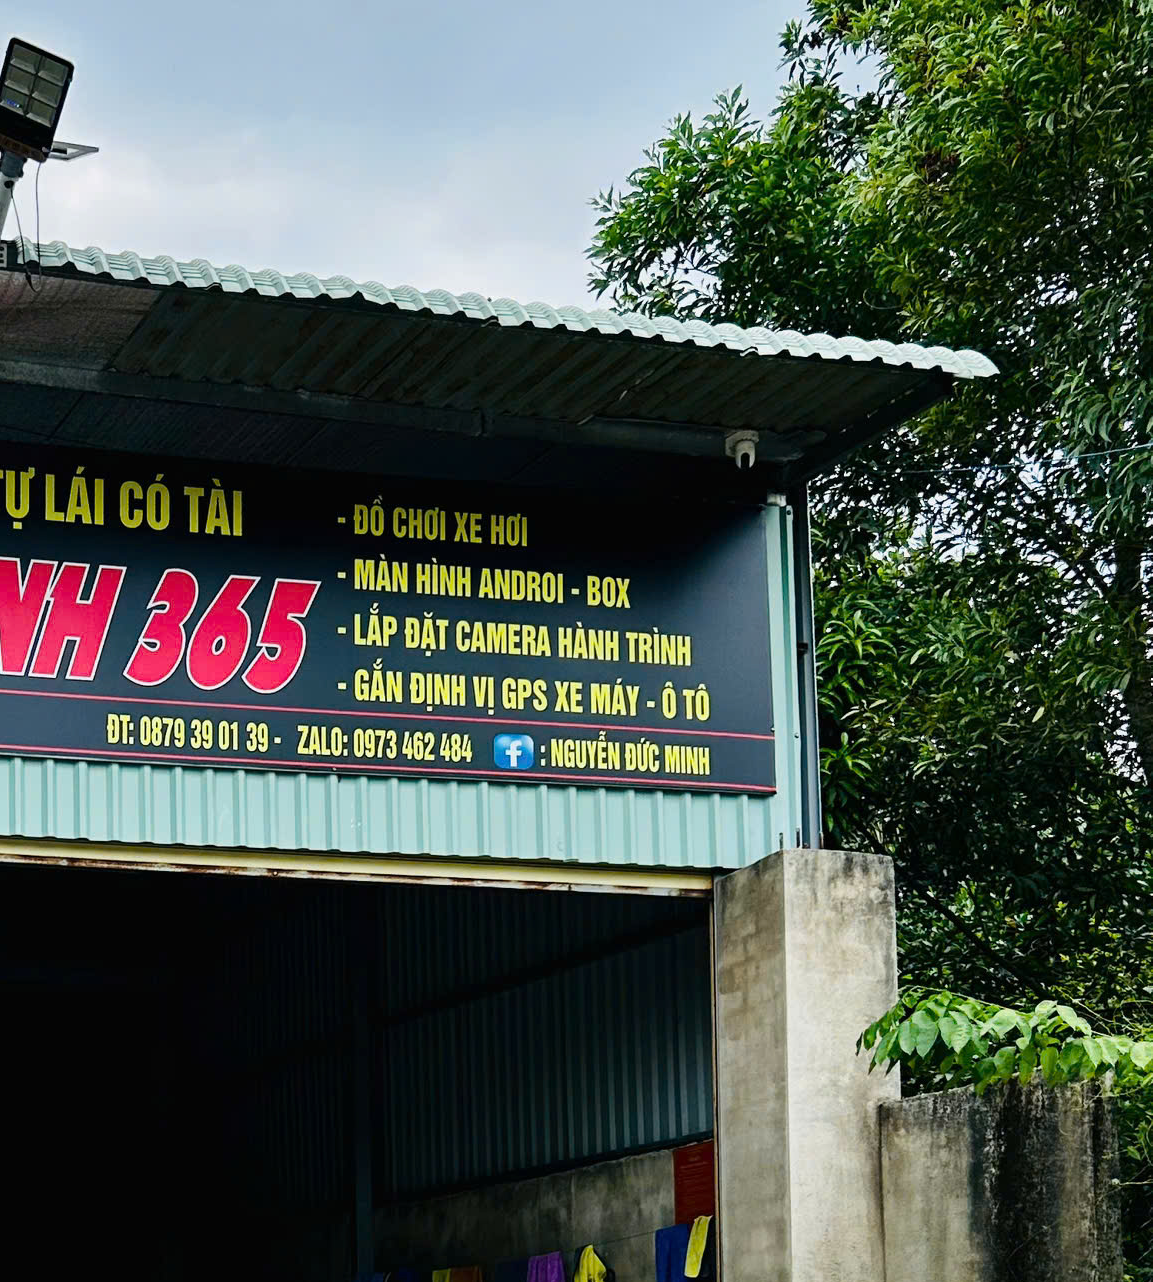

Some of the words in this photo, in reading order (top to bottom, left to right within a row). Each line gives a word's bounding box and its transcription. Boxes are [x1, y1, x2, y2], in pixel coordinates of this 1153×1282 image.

[44, 466, 105, 526] LÁI
[119, 473, 170, 531] CÓ
[183, 479, 243, 537] TÀI
[353, 495, 386, 537] ĐỒ
[392, 507, 446, 541] CHƠI
[454, 511, 483, 544] XE
[490, 513, 528, 547] HƠI
[354, 553, 409, 593] MÀN
[416, 557, 472, 598] HÌNH
[478, 567, 564, 604] ANDROI
[586, 575, 631, 609] BOX
[123, 567, 321, 694] 365
[354, 603, 399, 647] LẮP
[404, 611, 449, 657] ĐẶT
[455, 620, 552, 657] CAMERA
[557, 621, 620, 662] HÀNH
[625, 626, 692, 667] TRÌNH
[354, 658, 403, 703] GẮN
[409, 671, 467, 712] ĐỊNH
[472, 675, 495, 715] VỊ
[501, 677, 548, 712] GPS
[554, 680, 584, 714] XE
[589, 677, 640, 717] MÁY
[661, 680, 677, 720] Ô
[682, 683, 710, 722] TÔ
[106, 713, 135, 745] ĐT:
[139, 715, 186, 748] 0879
[190, 718, 214, 750] 39
[218, 720, 239, 751] 01
[246, 721, 269, 753] 39
[297, 724, 348, 757] ZALO:
[353, 727, 398, 760] 0973
[401, 731, 436, 761] 462
[439, 733, 473, 763] 484
[550, 731, 621, 771] NGUYỄN
[624, 737, 660, 773] ĐỨC
[664, 744, 711, 776] MINH
